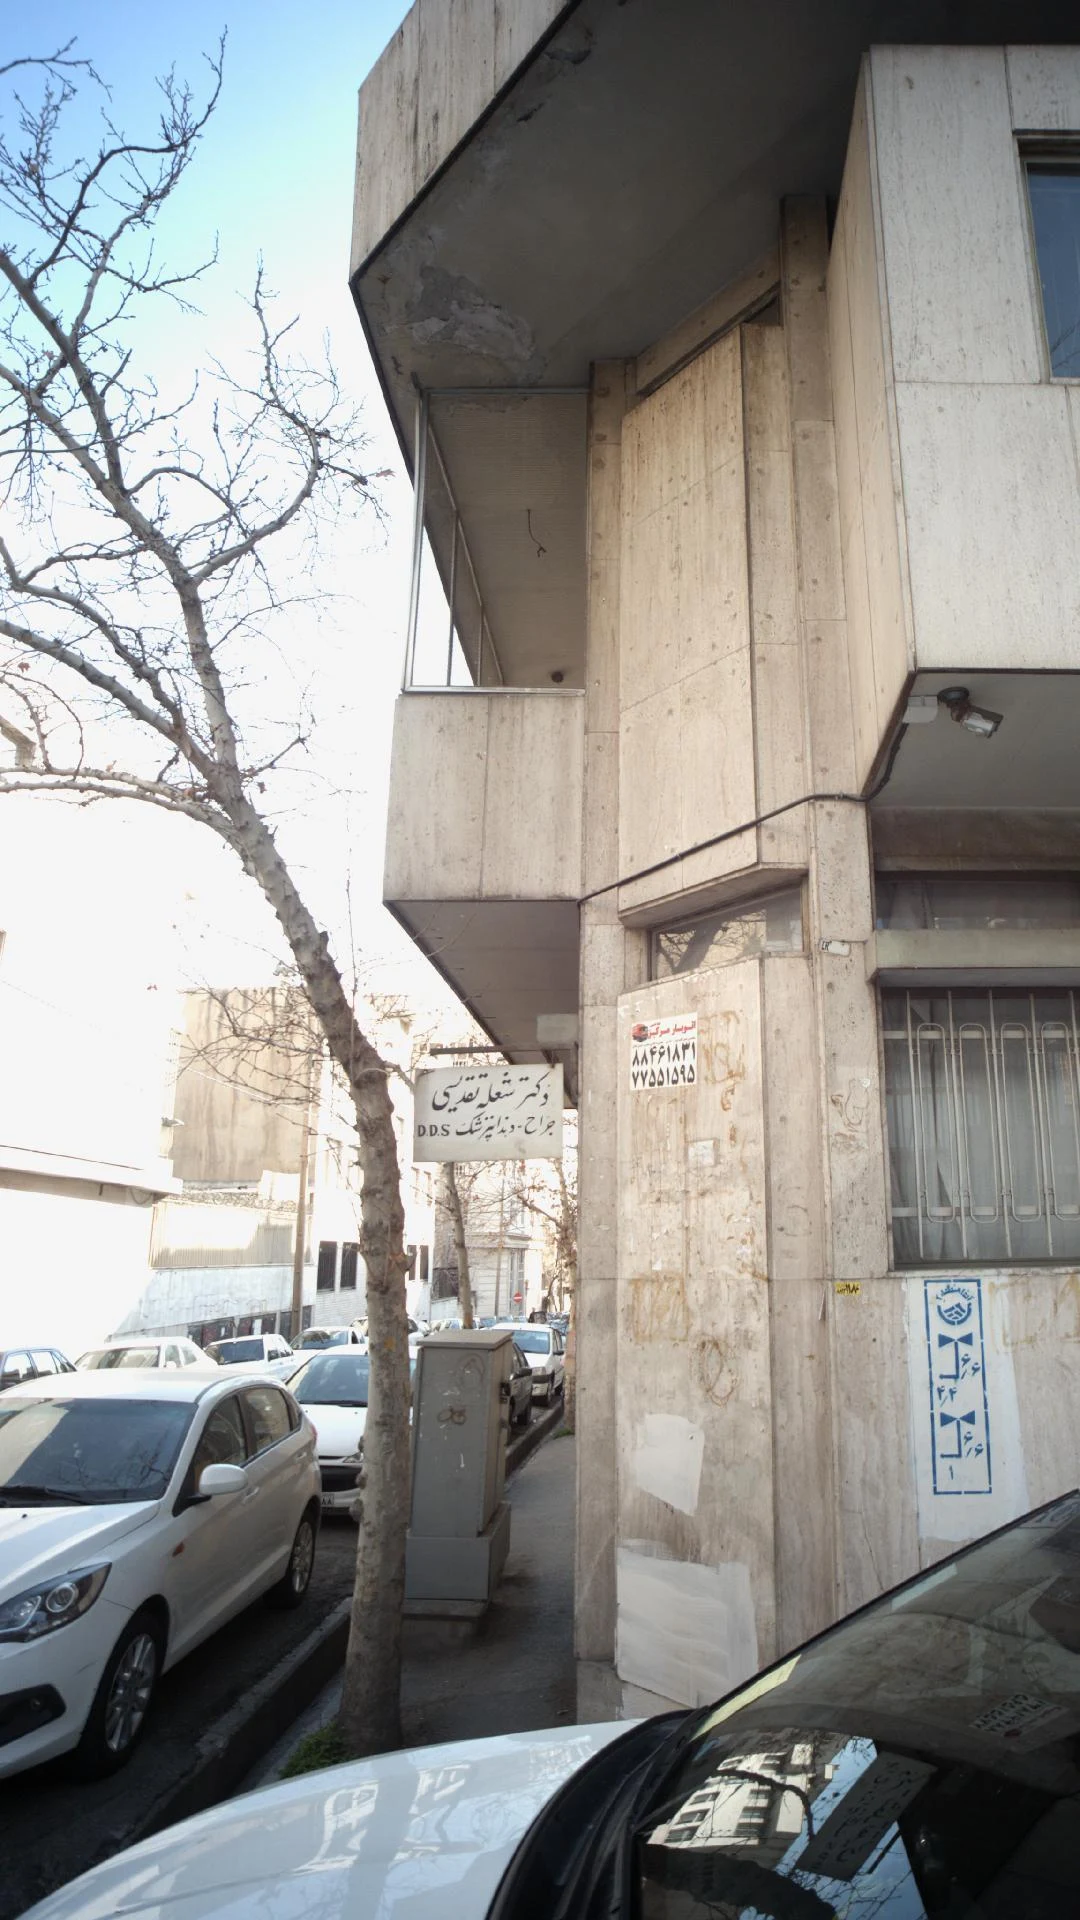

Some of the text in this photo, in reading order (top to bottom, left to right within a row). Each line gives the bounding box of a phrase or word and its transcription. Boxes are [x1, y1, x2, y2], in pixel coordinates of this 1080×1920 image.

[632, 1041, 696, 1066] ۸۸۴۶۱۸۳۱
[632, 1064, 695, 1088] ۷۷۵۵۱۵۹۵
[515, 1071, 550, 1110] دکتر
[524, 1115, 555, 1136] جراح
